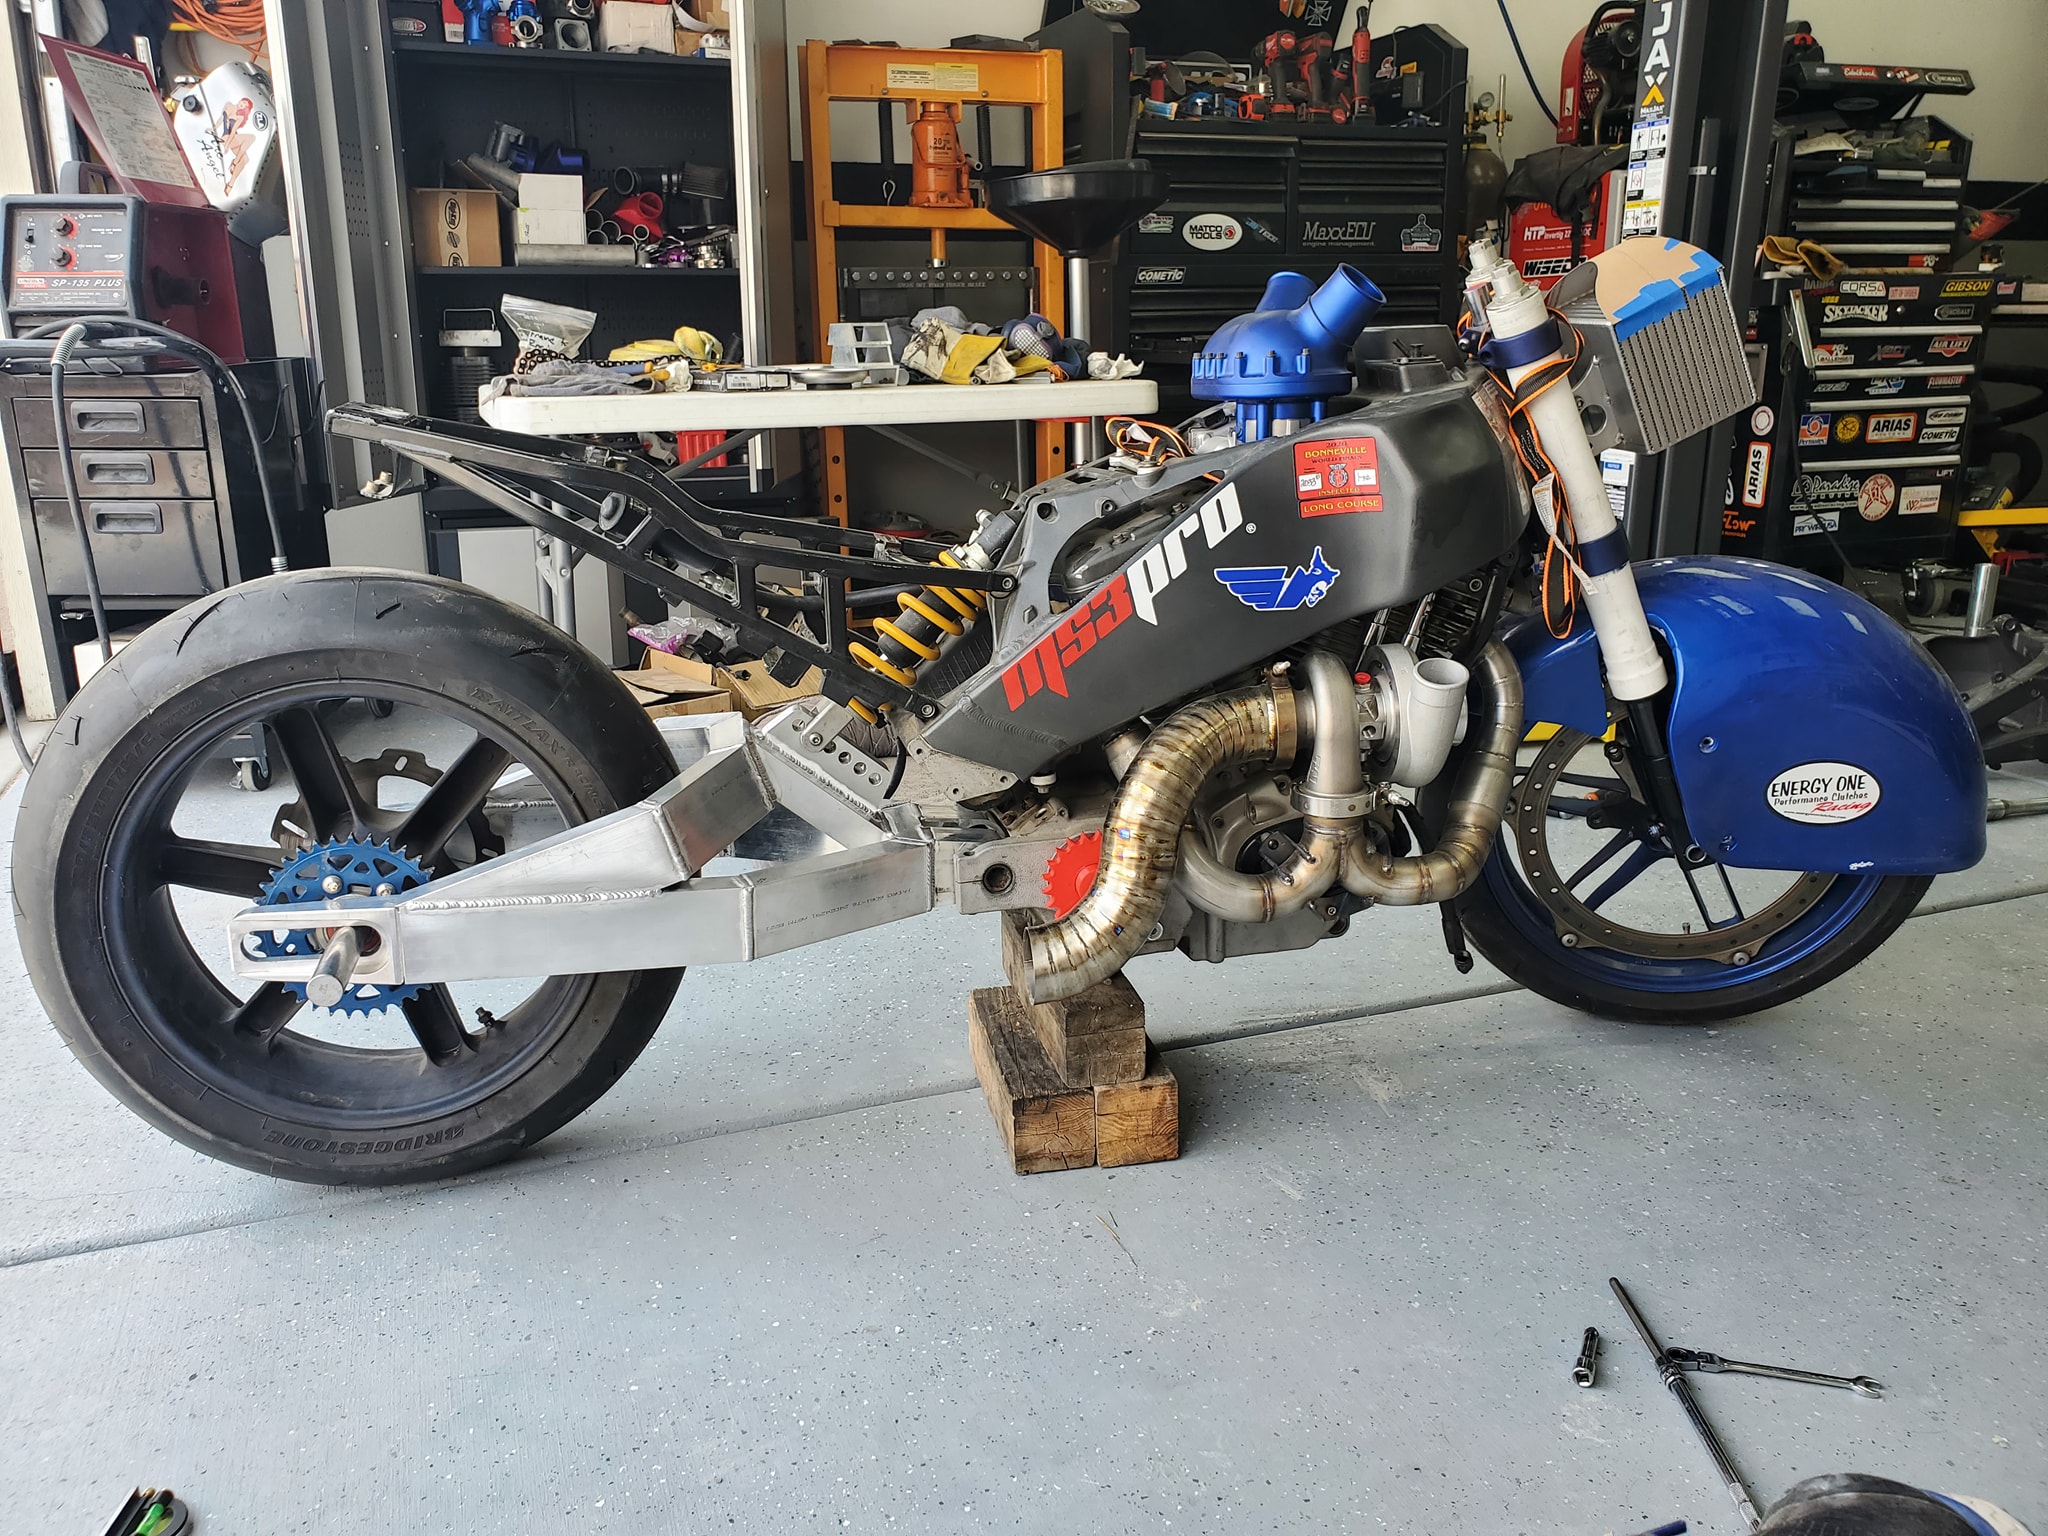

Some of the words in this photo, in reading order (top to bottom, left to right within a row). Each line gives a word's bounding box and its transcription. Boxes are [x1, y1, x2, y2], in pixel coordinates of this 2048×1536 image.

[1189, 225, 1222, 233] MATCO
[1302, 221, 1376, 241] MaxxECU
[1138, 268, 1184, 282] COMETIC
[51, 279, 91, 287] SP-135
[93, 279, 123, 287] PLUS
[1841, 282, 1884, 292] CORSA
[1945, 280, 1991, 292] GIBSON
[1823, 304, 1888, 323] SKYJACKER
[1933, 340, 1949, 349] AIR
[1950, 340, 1969, 349] LIFT
[1928, 376, 1963, 388] FLOWMASTER
[1872, 418, 1911, 432] ARIAS
[1921, 429, 1956, 440] COMETIC
[1304, 446, 1367, 458] BONNEVILLE
[1747, 449, 1763, 501] ARIAS
[1318, 487, 1360, 497] INSPECTED
[1304, 502, 1334, 513] LONG
[1337, 499, 1379, 509] COURSE
[1771, 777, 1833, 797] ENERGY
[1836, 774, 1868, 791] ONE
[1774, 796, 1829, 806] Performance
[1831, 791, 1869, 801] Clutches
[1810, 801, 1872, 813] Racing
[263, 1122, 465, 1156] BRIDGESTONE
